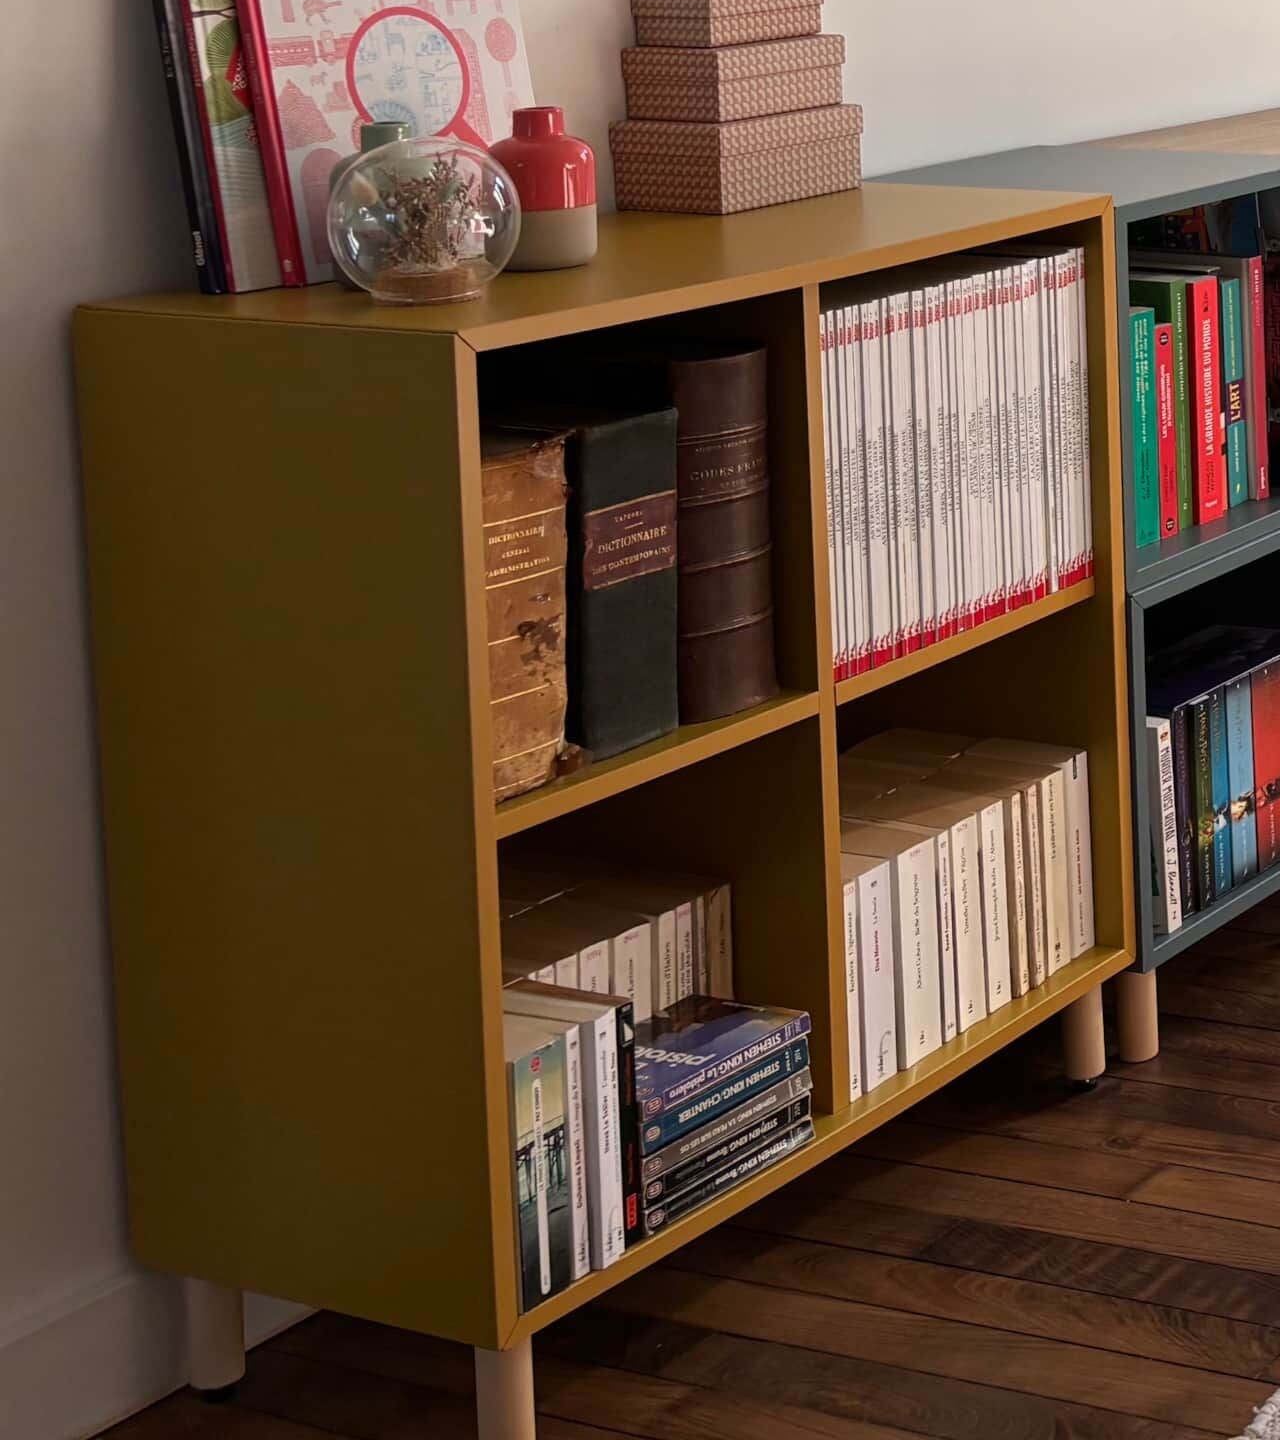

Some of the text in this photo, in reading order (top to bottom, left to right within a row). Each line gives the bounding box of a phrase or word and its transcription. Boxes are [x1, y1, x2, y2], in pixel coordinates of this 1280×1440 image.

[1202, 319, 1212, 350] MONDE
[1203, 366, 1213, 406] HISTOIRE
[1229, 383, 1241, 420] L'ART
[1204, 407, 1214, 443] GRANDE
[597, 525, 667, 554] DICTIONNAIRE
[1160, 746, 1172, 785] MURDER
[1161, 785, 1174, 812] MOST
[1163, 812, 1176, 841] ROYAL
[634, 1045, 716, 1068] pistole
[744, 1032, 782, 1059] STEPHEN
[669, 1069, 706, 1099] pistolero
[745, 1060, 781, 1088] STEPHEN
[752, 1094, 777, 1113] STEPHEN
[748, 1117, 778, 1142] STEPHEN
[757, 1138, 788, 1162] STEPHEN
